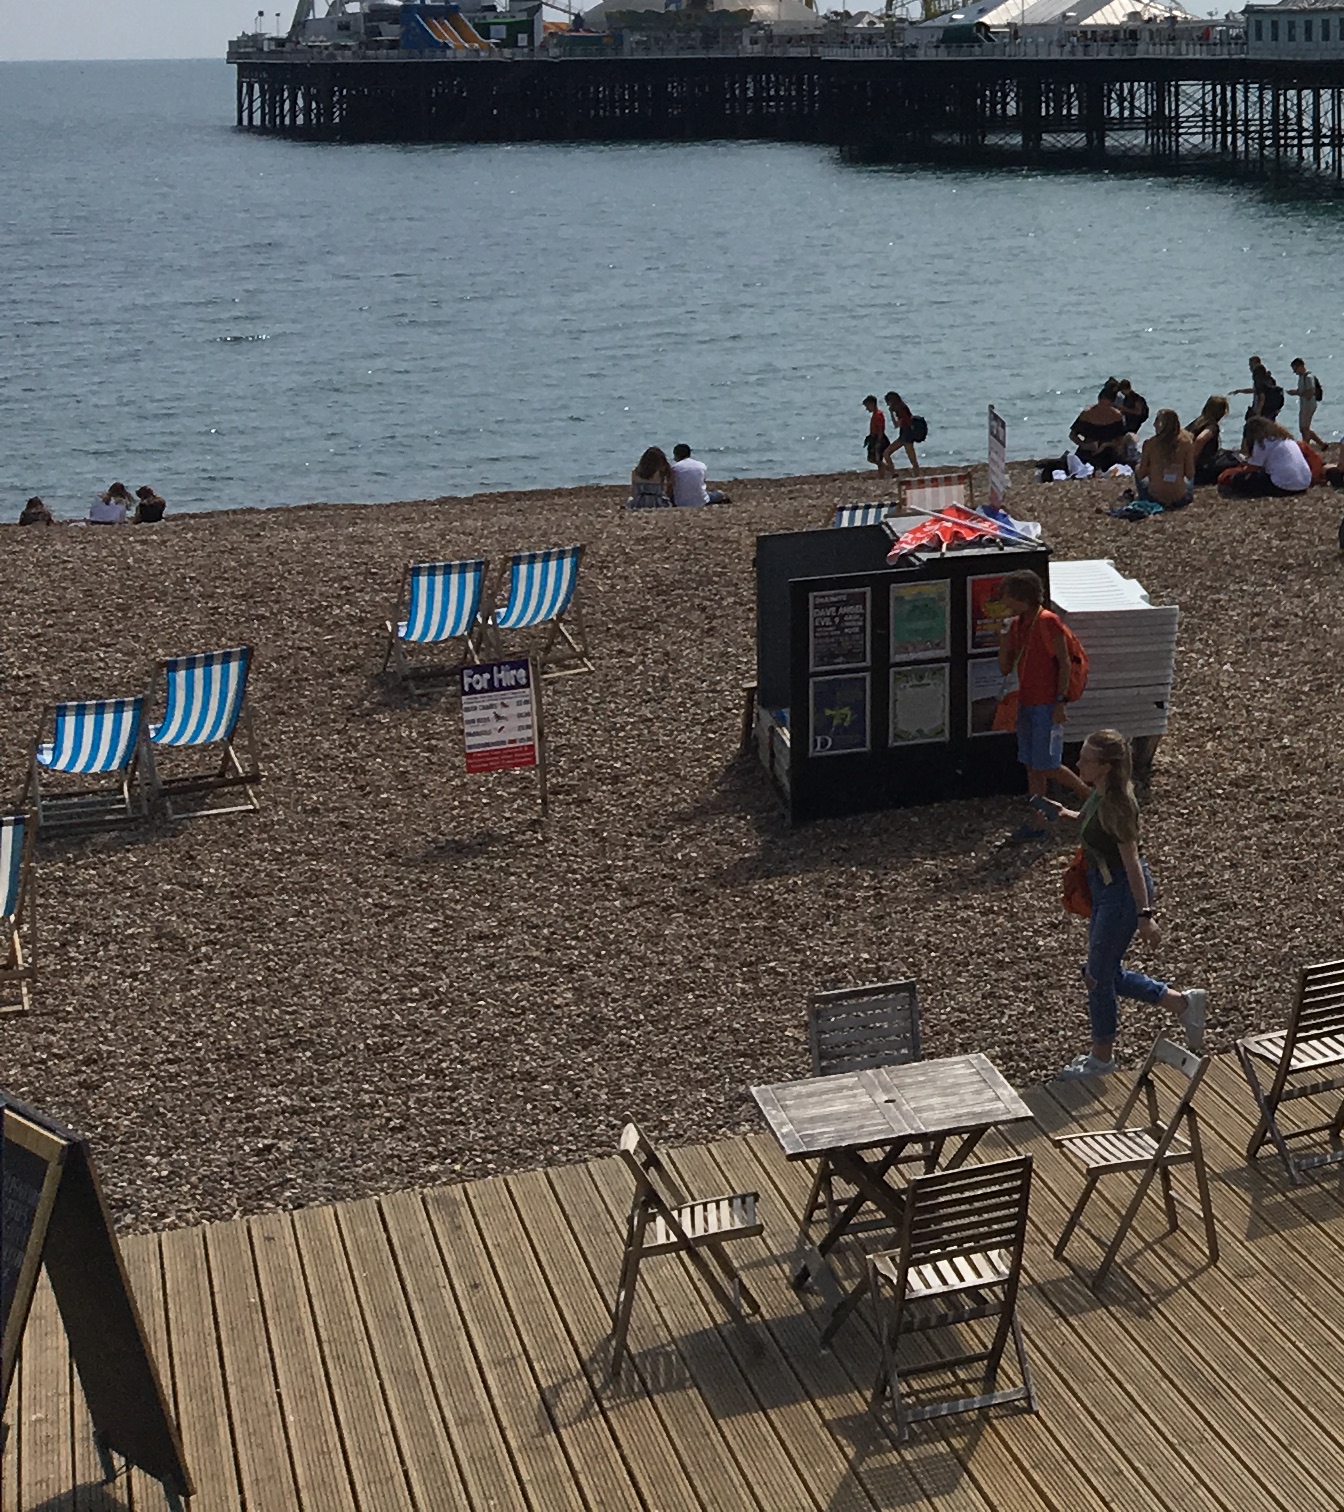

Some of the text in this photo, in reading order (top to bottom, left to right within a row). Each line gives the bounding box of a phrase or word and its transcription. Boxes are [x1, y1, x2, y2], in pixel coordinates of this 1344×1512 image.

[813, 605, 865, 617] DAVE ANGEL
[463, 664, 527, 692] For Hire
[814, 735, 832, 752] D
